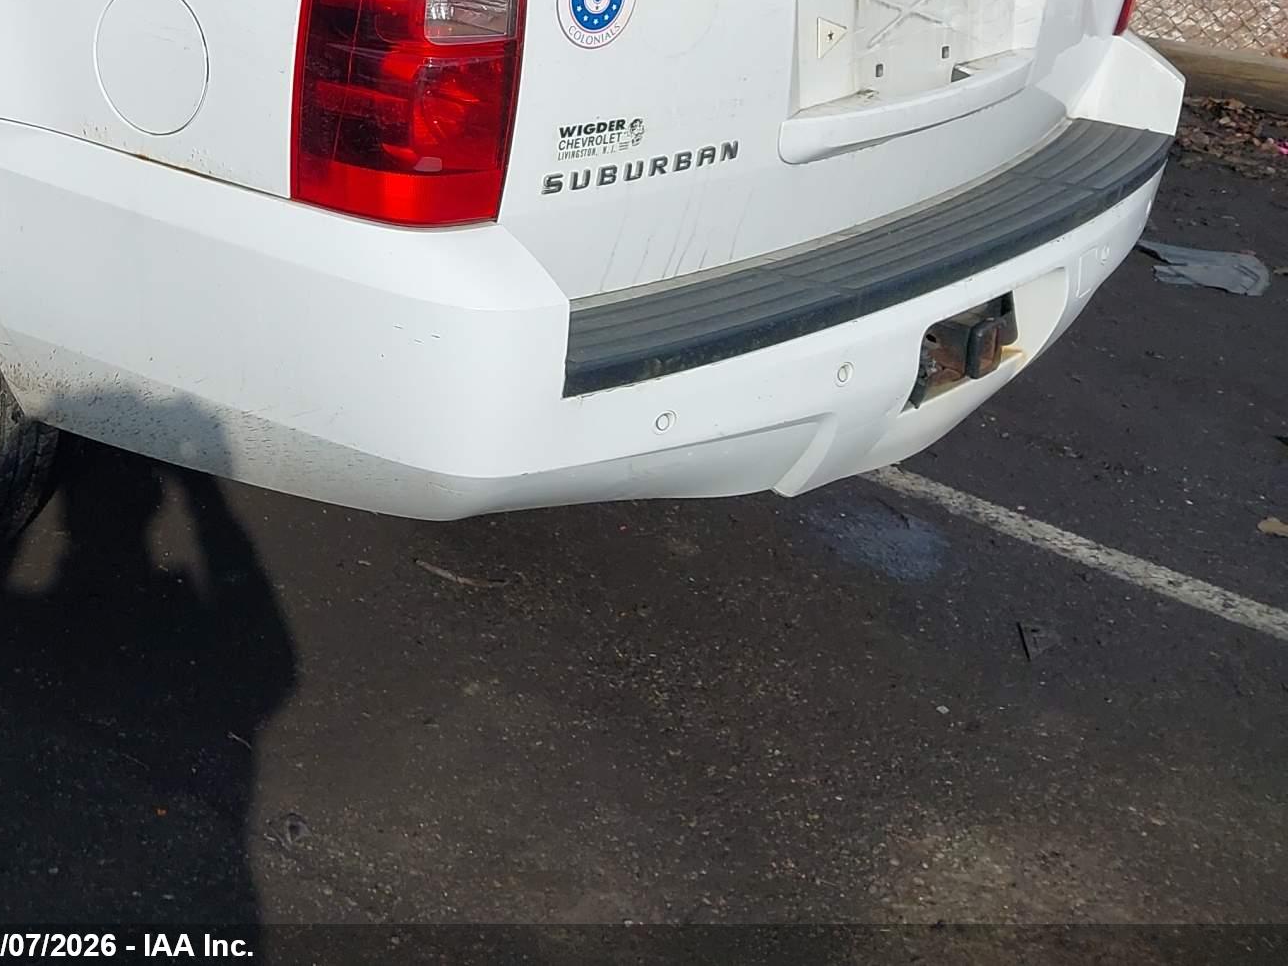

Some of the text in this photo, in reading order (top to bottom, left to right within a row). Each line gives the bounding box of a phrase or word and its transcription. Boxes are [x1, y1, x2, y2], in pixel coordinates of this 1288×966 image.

[568, 24, 621, 46] COLONIALS
[559, 119, 627, 139] WIGDER
[558, 132, 623, 151] CHEVROLET
[540, 140, 739, 195] SUBURBAN
